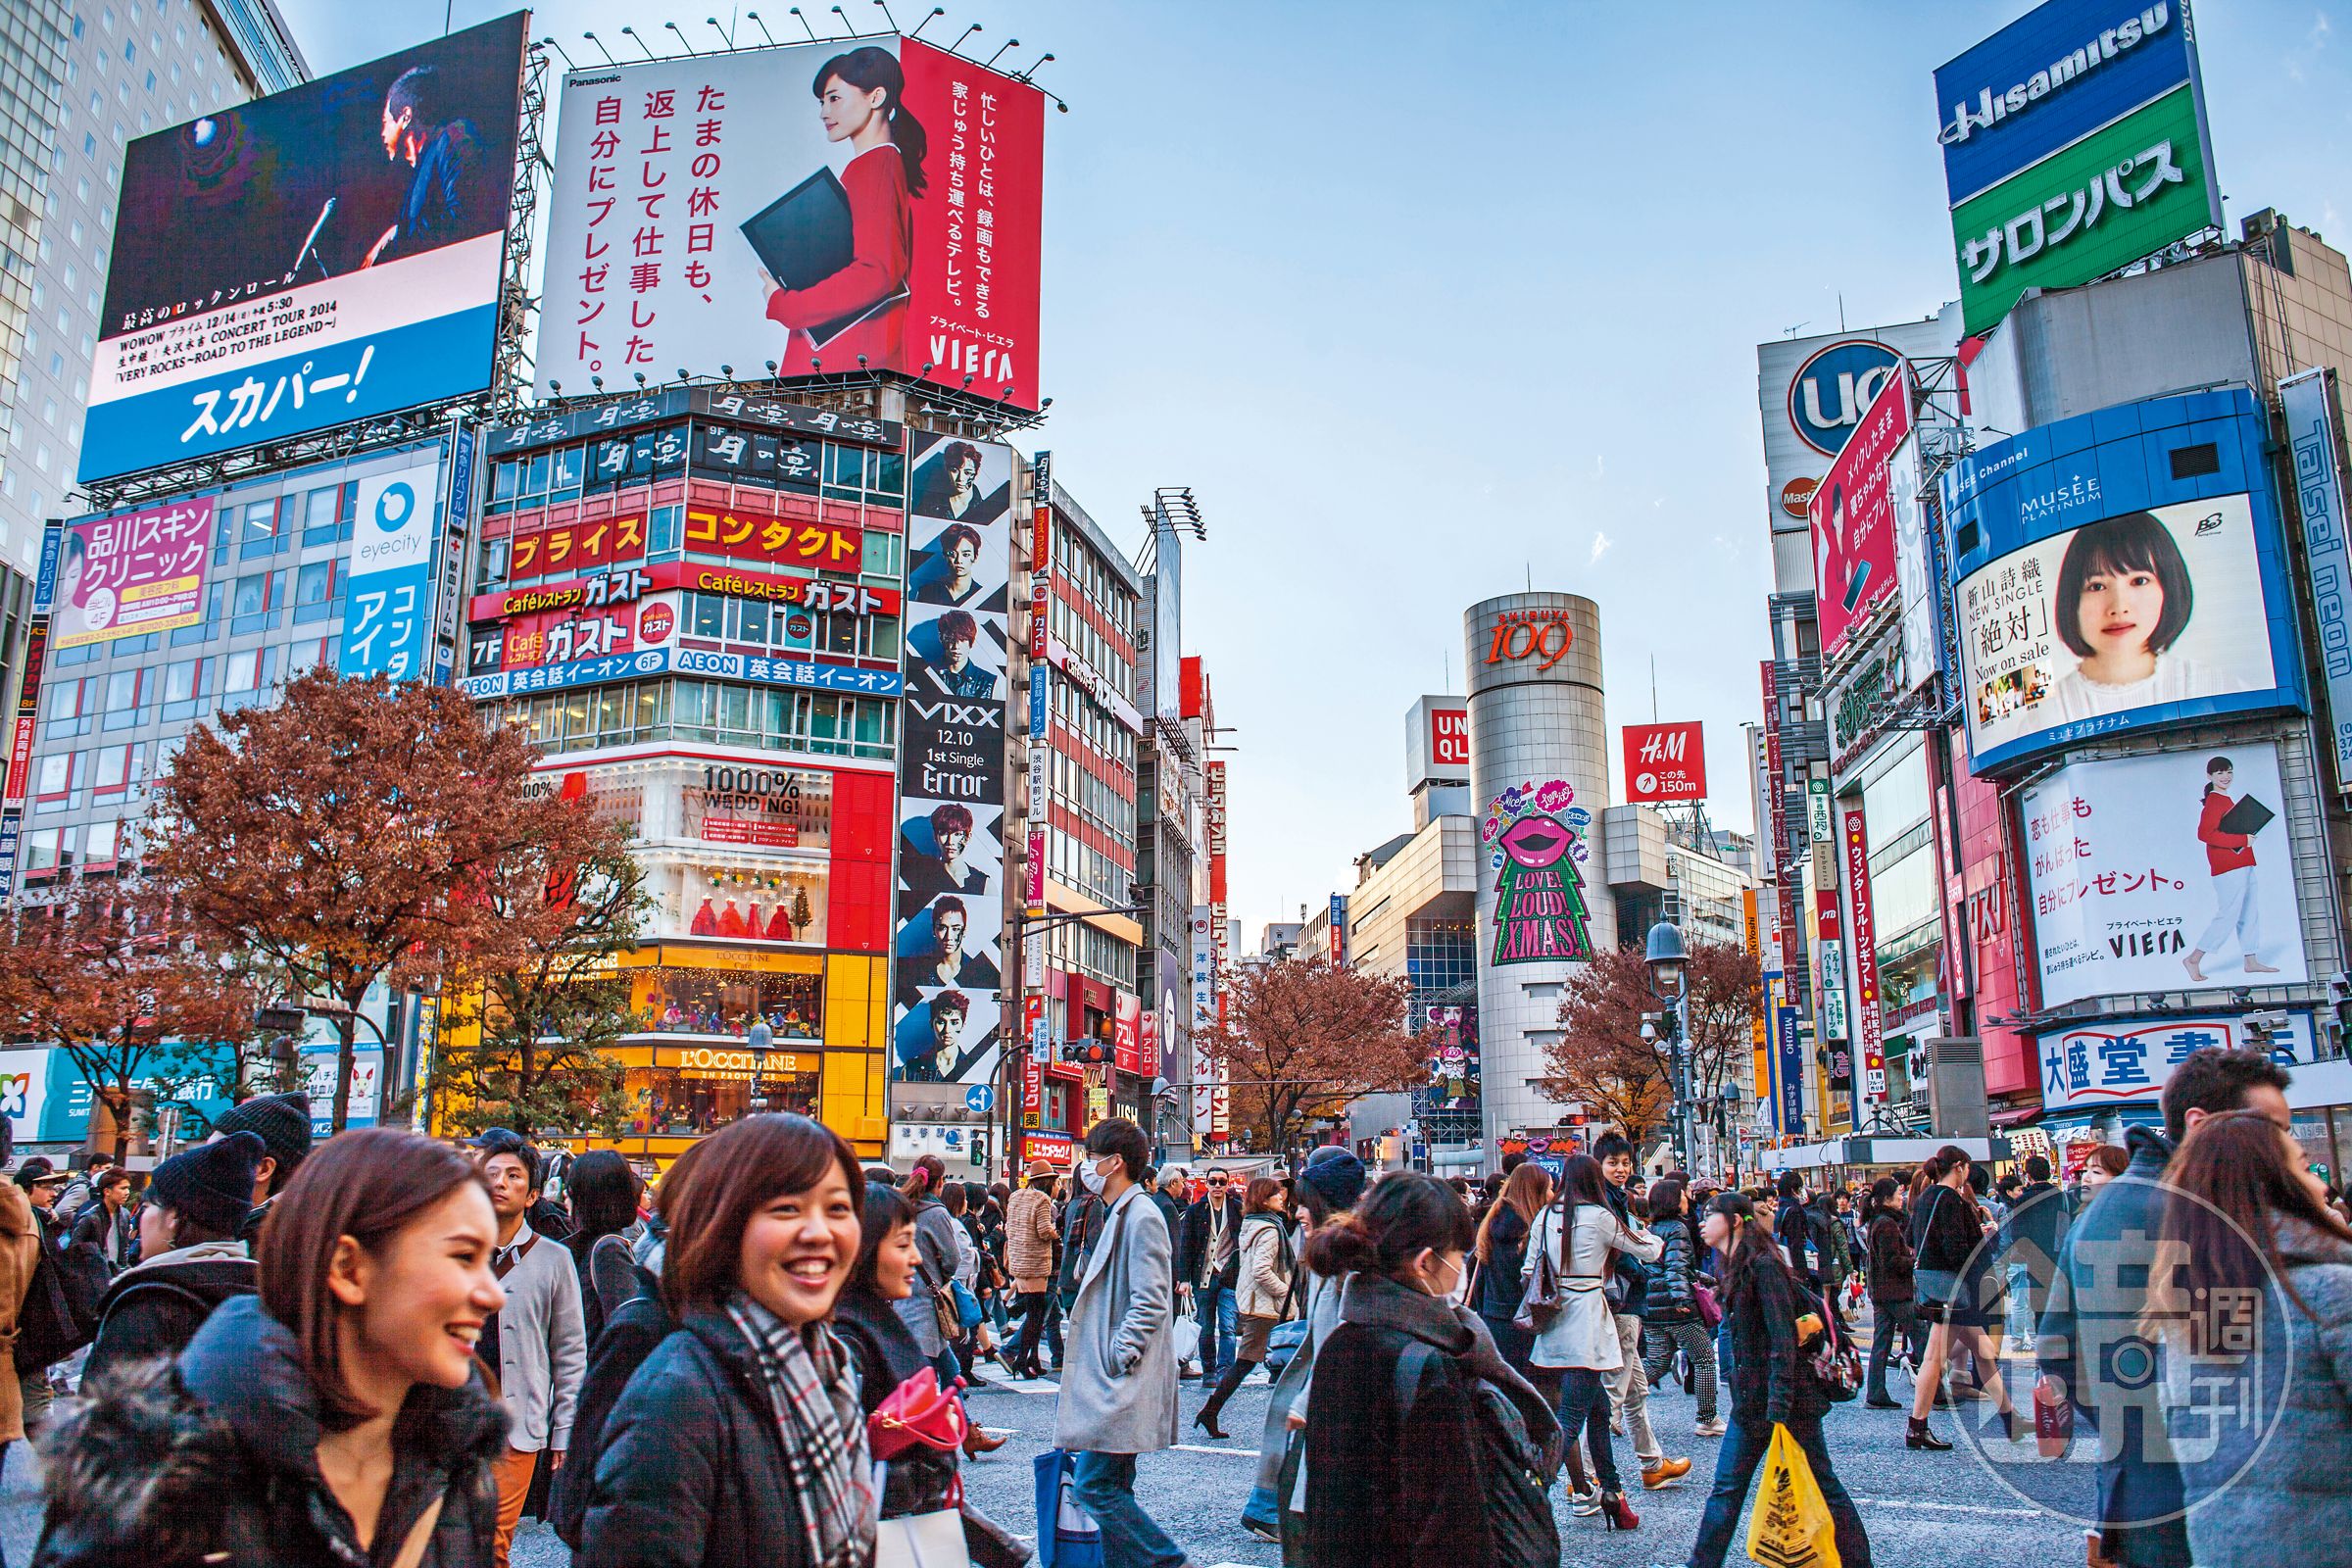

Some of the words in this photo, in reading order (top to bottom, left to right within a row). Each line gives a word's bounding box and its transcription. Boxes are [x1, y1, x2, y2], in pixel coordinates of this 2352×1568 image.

[568, 74, 621, 88] Panasonic
[1937, 0, 2171, 145] Hisamitsu
[683, 84, 726, 305] たまの休日も、
[946, 82, 968, 308] 家じゅう持ち運べるテレビ。
[974, 93, 997, 319] 忙しいひとは、録画もできる
[1961, 138, 2182, 284] サロンパス
[576, 95, 622, 372] 自分にプレゼント。
[624, 89, 676, 366] 返上して仕事した
[122, 270, 297, 330] 最高のロックンロール
[120, 330, 165, 352] WOWOW
[207, 313, 236, 328] 12/14
[268, 297, 292, 313] 5:30
[211, 319, 266, 343] CONCERT
[272, 309, 304, 326] TOUR
[310, 300, 337, 318] 2014
[230, 341, 247, 354] TO
[249, 335, 271, 351] THE
[180, 345, 374, 442] スカパー!
[594, 400, 655, 426] 月の宴
[711, 396, 789, 424] 月の宴
[506, 420, 564, 446] 月の宴
[709, 426, 725, 436] 9F
[807, 412, 881, 440] 月の宴
[599, 434, 681, 472] 月の宴
[600, 440, 612, 452] 9F
[708, 435, 812, 476] 月の宴
[1847, 407, 1893, 486] メイクしたまま
[1979, 447, 2029, 478] Channel
[453, 443, 470, 513] 東急リバブル
[2292, 418, 2342, 559] Taisei
[2021, 491, 2101, 524] PLATINUM
[87, 508, 209, 560] 品川スキン
[361, 533, 422, 563] eyecity
[514, 518, 642, 569] プライス
[686, 511, 856, 561] コンタクト
[38, 539, 57, 601] 東急リバブル
[84, 539, 205, 592] クリニック
[1967, 556, 2041, 606] 新山詩織
[444, 560, 458, 625] 献血ルーム
[584, 569, 652, 608] ガスト
[803, 580, 882, 616] ガスト
[1969, 599, 1990, 624] NEW
[1993, 580, 2044, 613] SINGLE
[643, 620, 671, 634] ガスト
[789, 623, 809, 634] ガスト
[1034, 616, 1046, 651] ガスト
[1497, 609, 1570, 623] SHIBUYA
[1971, 597, 2048, 666] 「絶対」
[2314, 563, 2352, 680] neon
[472, 638, 503, 664] 7F
[509, 630, 544, 654] Café
[509, 651, 542, 664] レストラン
[545, 614, 627, 664] ガスト
[1483, 620, 1573, 670] 109
[463, 675, 503, 695] AEON
[513, 659, 630, 692] 英会話イーオン
[640, 655, 658, 669] 6F
[677, 651, 738, 674] AEON
[749, 658, 897, 692] 英会話イーオン
[1975, 663, 1998, 684] Now
[1999, 657, 2017, 671] on
[2019, 642, 2050, 667] sale
[22, 699, 36, 708] 8F
[908, 698, 1001, 729] VIXX
[1033, 674, 1044, 733] 英会話イーオン
[16, 718, 31, 761] 外貨両替
[937, 729, 973, 746] 12.10
[2048, 714, 2130, 741] ミュゼプラチナム
[927, 748, 947, 762] 1st
[949, 752, 984, 768] Single
[1640, 731, 1688, 764] H&M
[705, 766, 800, 799] 1000%
[922, 762, 989, 798] Error
[1032, 755, 1042, 817] 渋谷駅前ビル
[1659, 770, 1687, 780] この先
[1660, 781, 1697, 793] 150m
[704, 792, 800, 814] WEDDING!
[2024, 791, 2038, 803] Panasonic
[1030, 832, 1044, 841] 5F
[2030, 796, 2092, 842] 恋も仕事も
[2034, 836, 2092, 879] がんばった
[1514, 871, 1563, 891] LOVE!
[2038, 867, 2184, 917] 自分にプレゼント。
[1509, 892, 1571, 919] LOUD!
[1820, 909, 1837, 920] JTB
[1851, 845, 1873, 988] ウィンターフルーツギフト
[1501, 918, 1583, 959] XMAS!
[1196, 953, 1206, 1021] 洋装生地
[1115, 1022, 1135, 1047] アコム
[1785, 1017, 1793, 1054] MIZUHO
[1870, 1001, 1883, 1056] 無料配送地域
[720, 1071, 776, 1080] PROVECE
[1025, 1112, 1039, 1127] 薬
[1787, 1083, 1798, 1125] みずほ銀行
